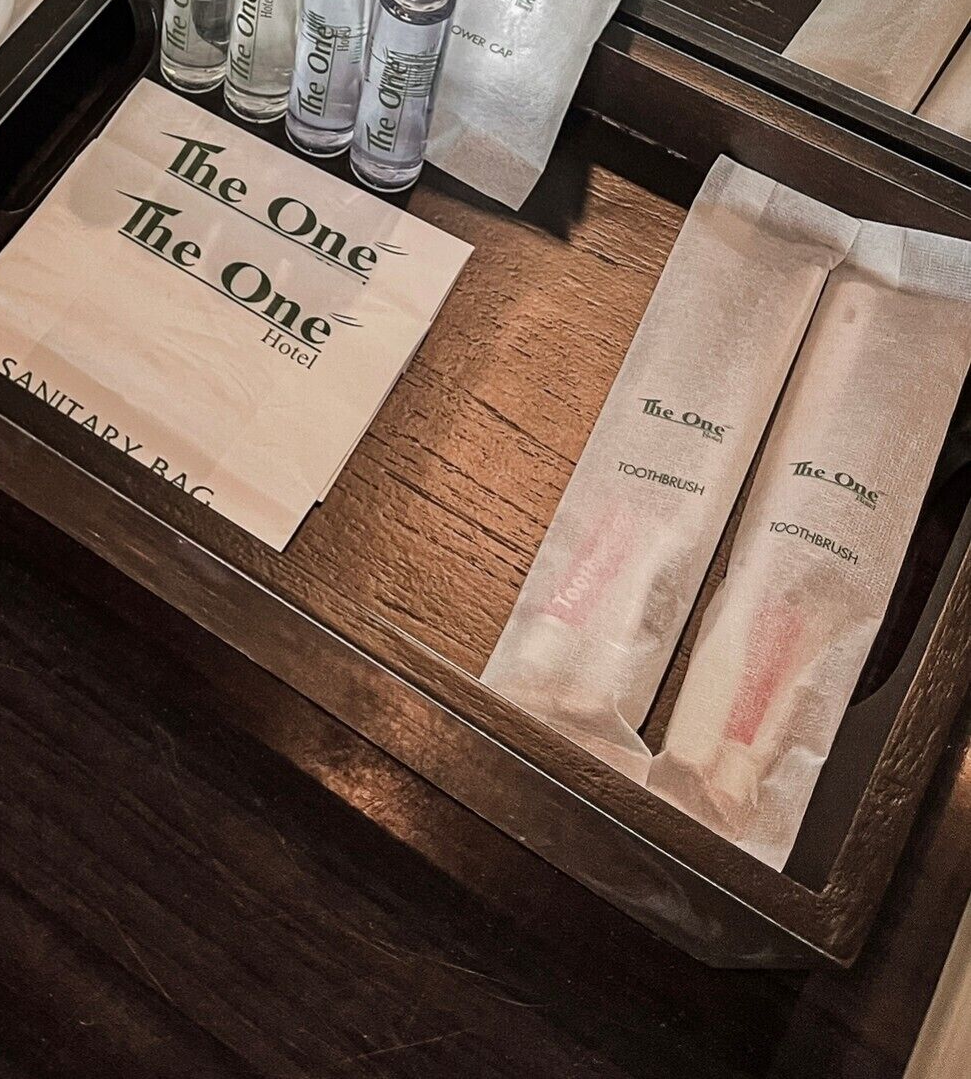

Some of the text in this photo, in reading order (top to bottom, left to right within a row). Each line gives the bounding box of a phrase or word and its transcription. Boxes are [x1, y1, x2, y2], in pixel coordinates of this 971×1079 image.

[165, 15, 188, 51] The
[450, 24, 513, 58] OWER CAP
[230, 43, 252, 81] The
[297, 25, 335, 117] The One
[365, 116, 396, 152] The
[160, 131, 378, 271] The One
[115, 189, 332, 345] The One
[259, 327, 319, 370] Hotel
[1, 357, 144, 455] SANITARY
[638, 397, 674, 420] The
[681, 411, 725, 437] One
[617, 460, 705, 496] TOOTHBRUSH
[789, 460, 826, 479] The
[834, 472, 879, 503] One
[769, 521, 859, 565] TOOTHBRUSH
